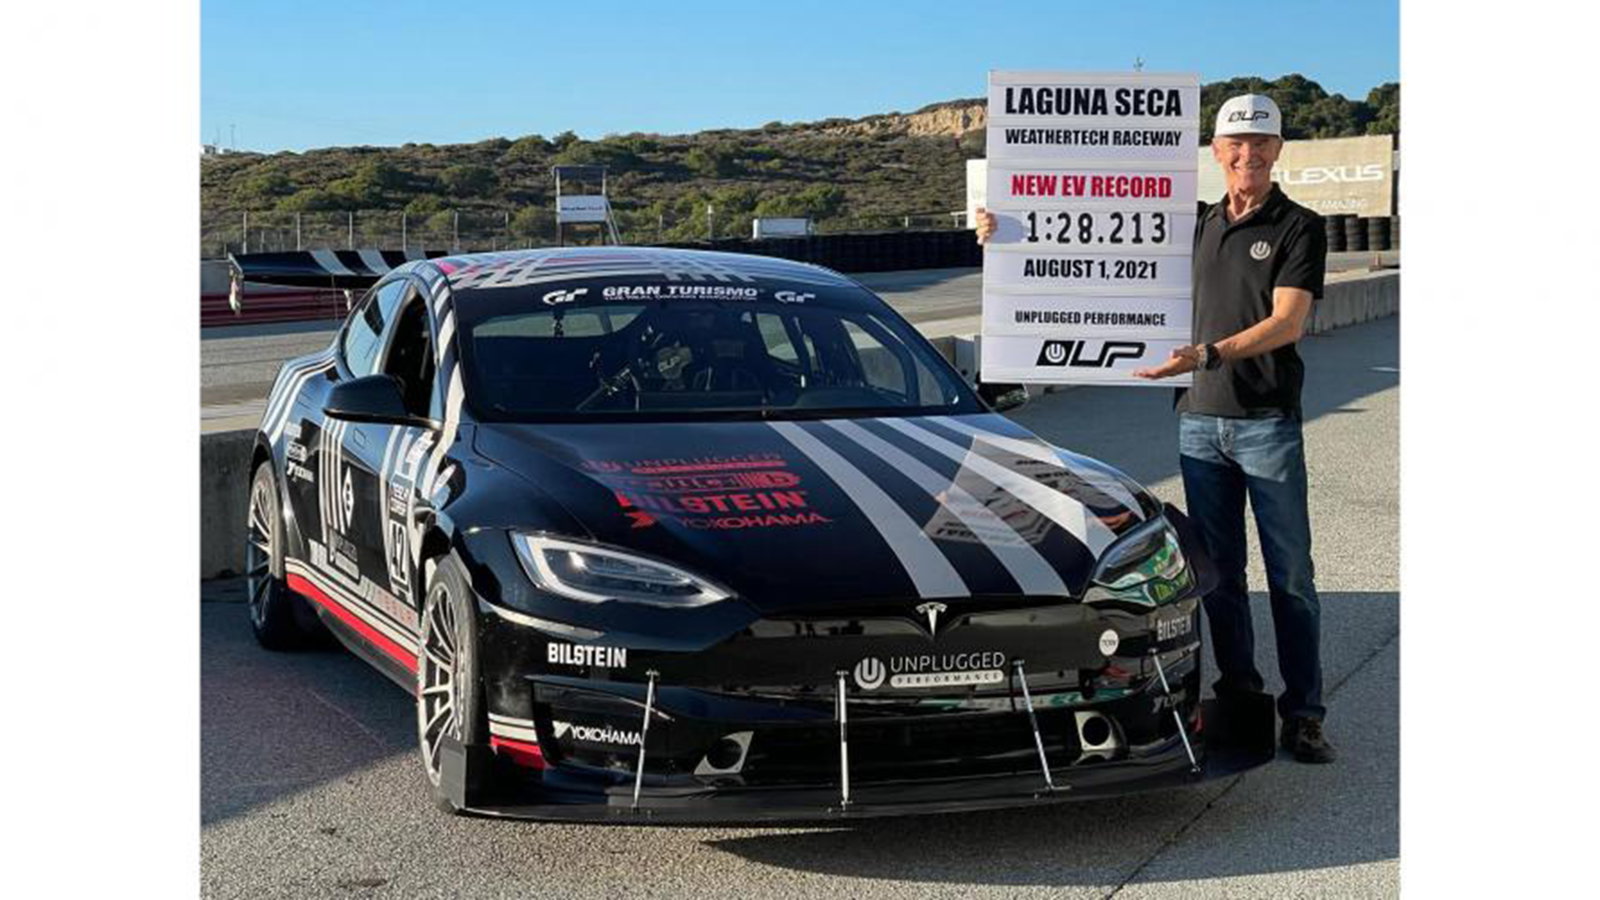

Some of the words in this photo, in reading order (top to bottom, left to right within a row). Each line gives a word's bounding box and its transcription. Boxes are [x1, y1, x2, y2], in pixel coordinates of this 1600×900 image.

[1005, 87, 1108, 116] LAGUNA
[1115, 88, 1182, 117] SECA
[1005, 129, 1109, 146] WEATHERTECH
[1113, 130, 1182, 147] RACEWAY
[1283, 164, 1384, 185] LEXUS
[1011, 174, 1057, 196] NEW
[1061, 175, 1086, 197] EV
[1090, 176, 1172, 198] RECORD
[1026, 211, 1166, 244] 1:28.213
[1023, 259, 1094, 278] AUGUST
[1099, 260, 1110, 280] 1,
[1114, 260, 1157, 280] 2021
[602, 286, 661, 297] GRAN
[666, 286, 758, 297] TURISMO
[1015, 310, 1081, 325] UNPLUGGED
[1084, 311, 1166, 326] PERFORMANCE
[547, 642, 628, 668] BILSTEIN
[890, 651, 1006, 674] UNPLUGGED
[896, 672, 999, 685] PERFORMANCE
[569, 725, 643, 746] YOKOHAMA
